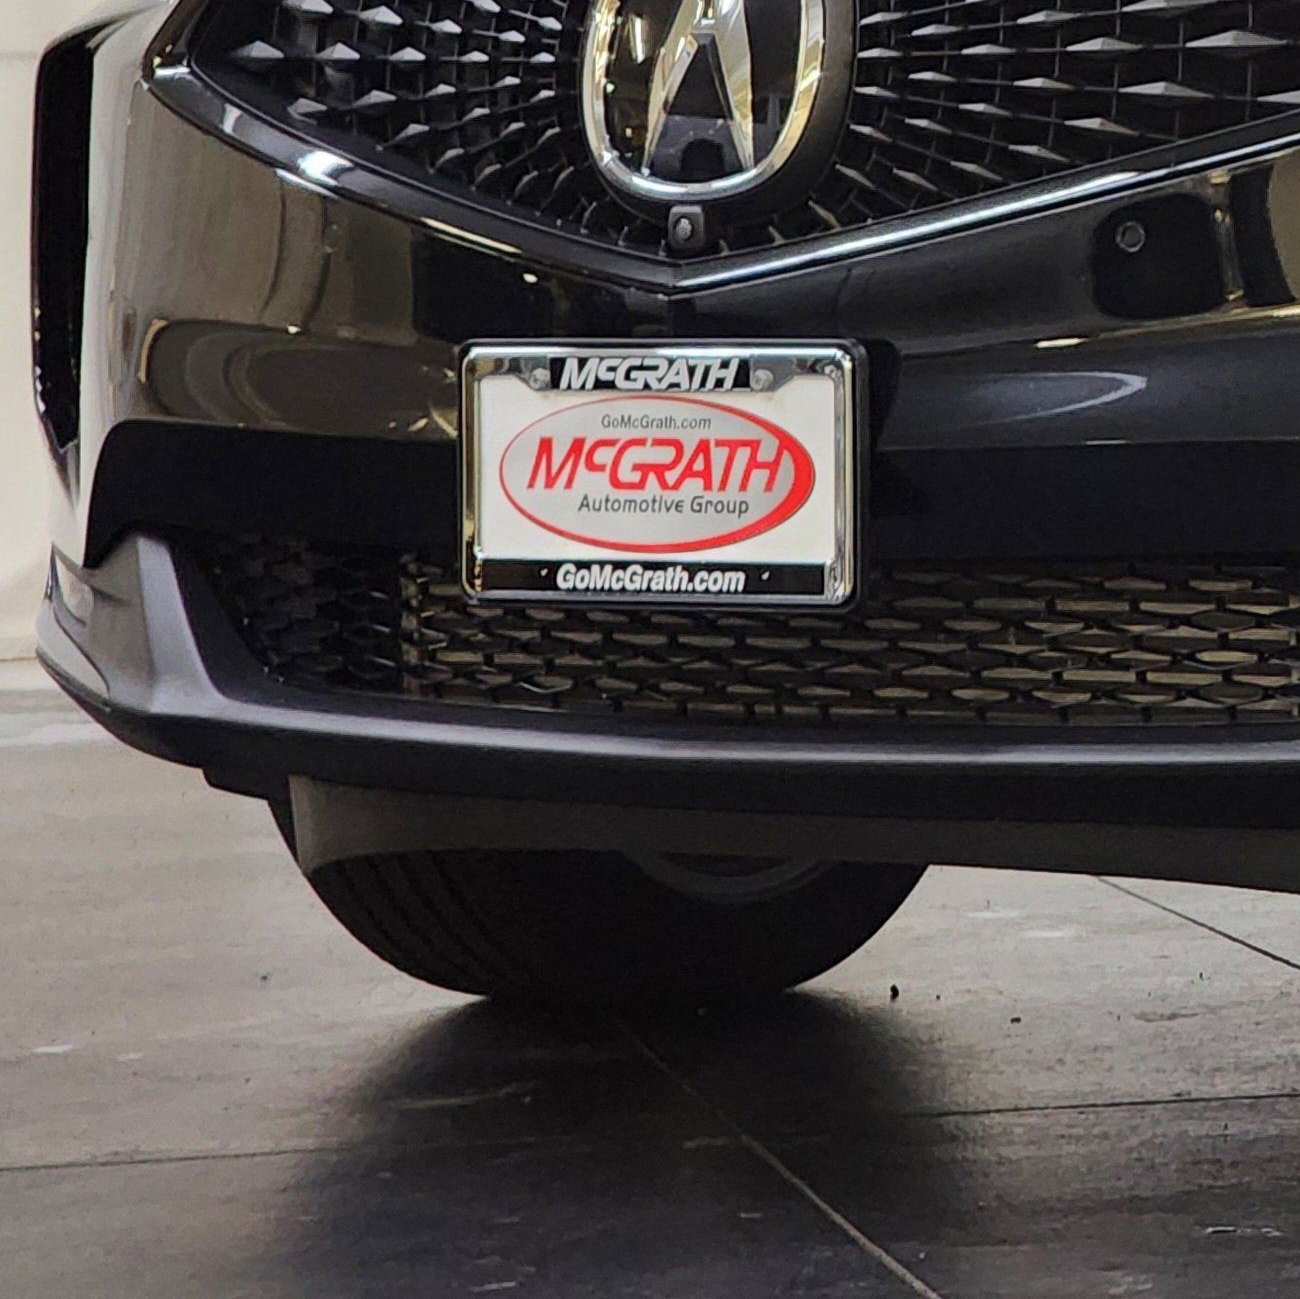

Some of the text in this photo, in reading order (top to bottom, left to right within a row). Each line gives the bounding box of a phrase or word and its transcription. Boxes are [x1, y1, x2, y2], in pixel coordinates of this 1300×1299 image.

[600, 414, 713, 431] GoMcGrath.com
[577, 493, 750, 519] Automotive Group
[555, 562, 747, 593] GoMcGrath.com
